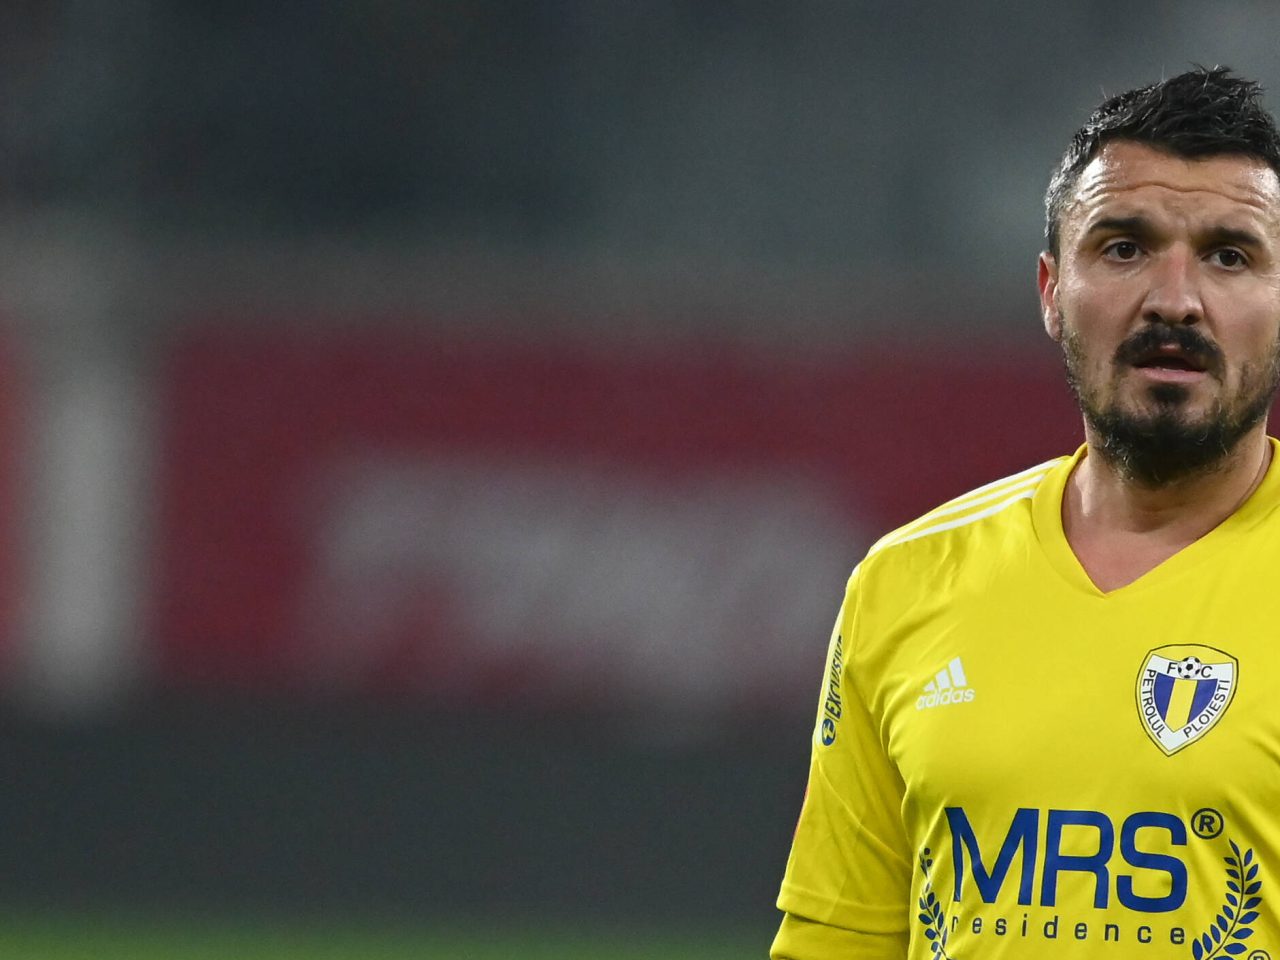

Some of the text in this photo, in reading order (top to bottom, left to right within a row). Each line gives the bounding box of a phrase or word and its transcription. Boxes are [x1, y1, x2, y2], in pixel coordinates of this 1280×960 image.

[915, 687, 976, 711] adidas
[1142, 668, 1166, 739] PETROLUL
[1183, 679, 1231, 738] PLOIESTI
[944, 806, 1188, 913] MRS
[951, 913, 1186, 945] residence
